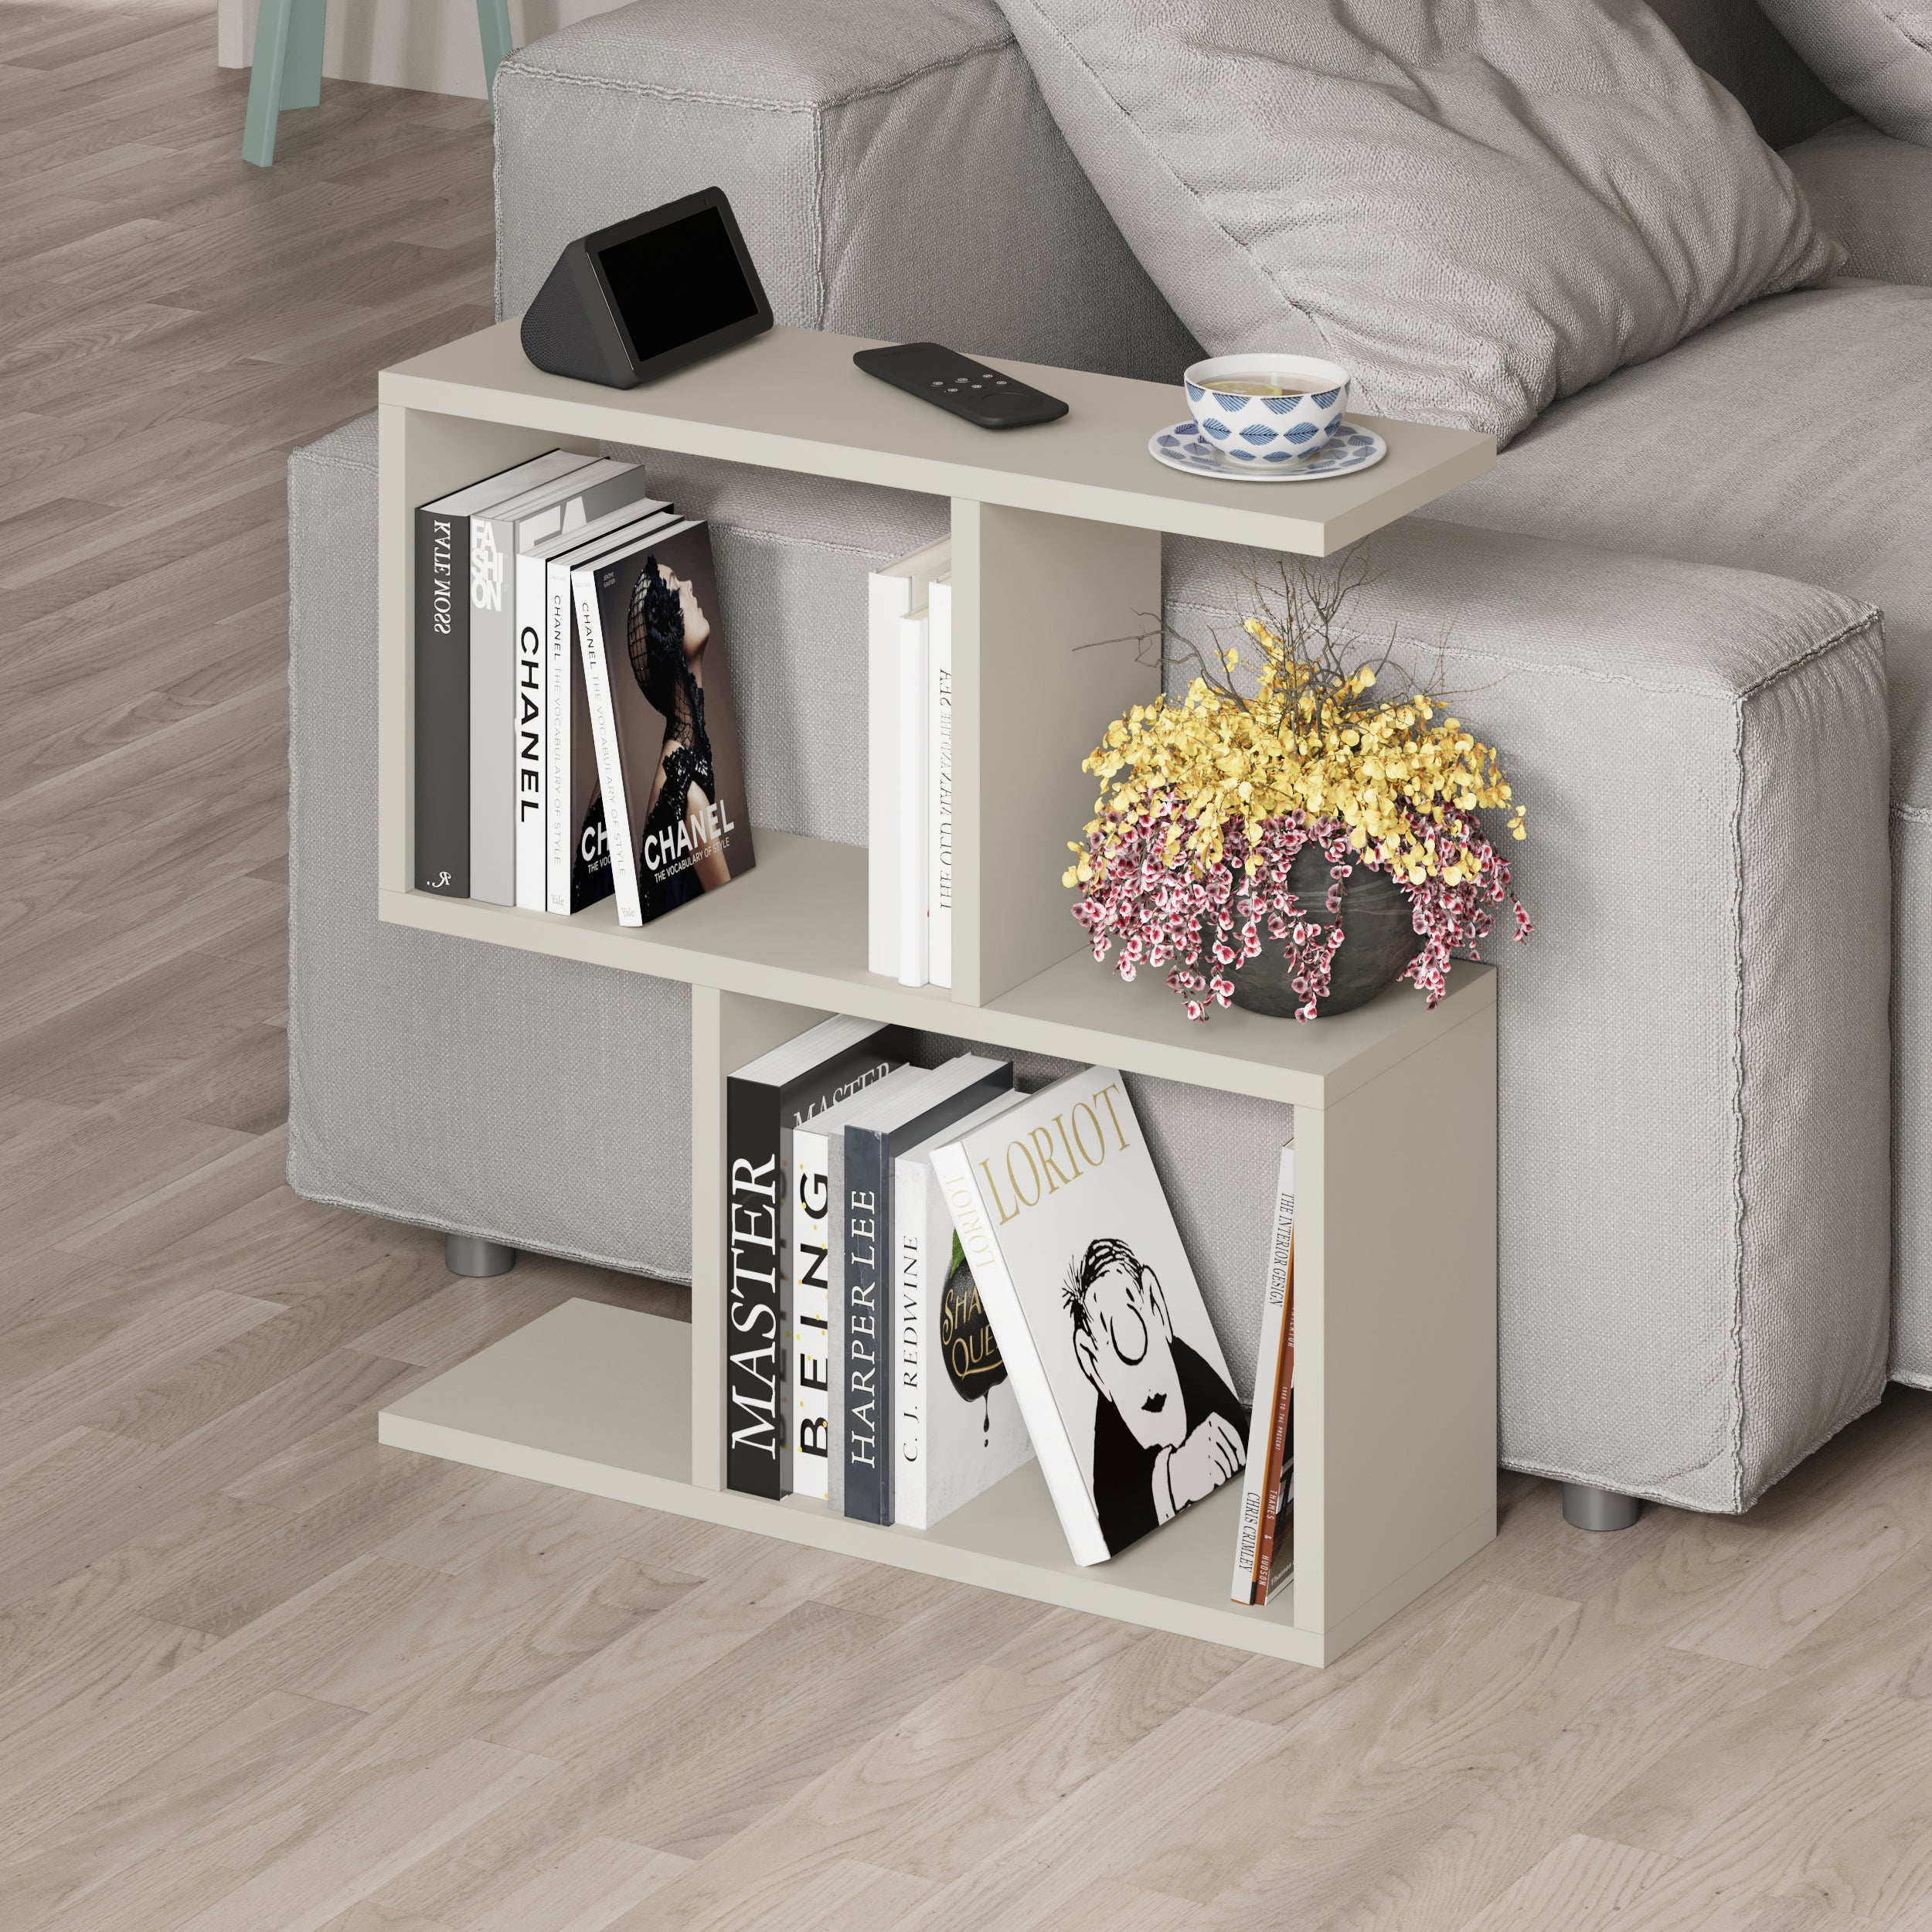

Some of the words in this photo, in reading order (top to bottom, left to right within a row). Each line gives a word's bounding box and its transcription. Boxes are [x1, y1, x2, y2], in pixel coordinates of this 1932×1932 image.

[582, 602, 597, 669] CHANEL
[593, 675, 602, 701] THE
[521, 626, 539, 823] CHANEL
[597, 706, 616, 804] VOCABULARY
[554, 798, 561, 817] OF
[611, 808, 619, 825] OF
[614, 832, 626, 876] STYLE
[645, 799, 735, 871] CHANEL
[588, 860, 599, 874] THE
[654, 869, 666, 883] THE
[665, 851, 704, 876] VOCABULARY
[703, 846, 713, 858] OF
[713, 836, 730, 855] STYLE
[551, 894, 564, 906] Yale
[621, 907, 634, 917] Yale
[978, 1082, 1131, 1226] LORIOT
[943, 1174, 997, 1268] LORIOT
[1280, 1192, 1294, 1215] THE
[851, 1190, 876, 1270] LEE
[1274, 1214, 1293, 1267] INTERIOR
[730, 1153, 777, 1461] MASTER
[799, 1172, 828, 1459] BEING
[903, 1235, 918, 1390] REDWINE
[942, 1285, 987, 1346] SHA
[851, 1281, 876, 1469] HARPER
[951, 1325, 1003, 1382] QUE
[903, 1405, 920, 1424] J.
[903, 1434, 919, 1464] C.
[1244, 1492, 1260, 1525] CHRIS
[1266, 1489, 1278, 1521] THAMES
[1239, 1526, 1257, 1573] CRIMLEY
[1258, 1555, 1270, 1587] HUDSON
